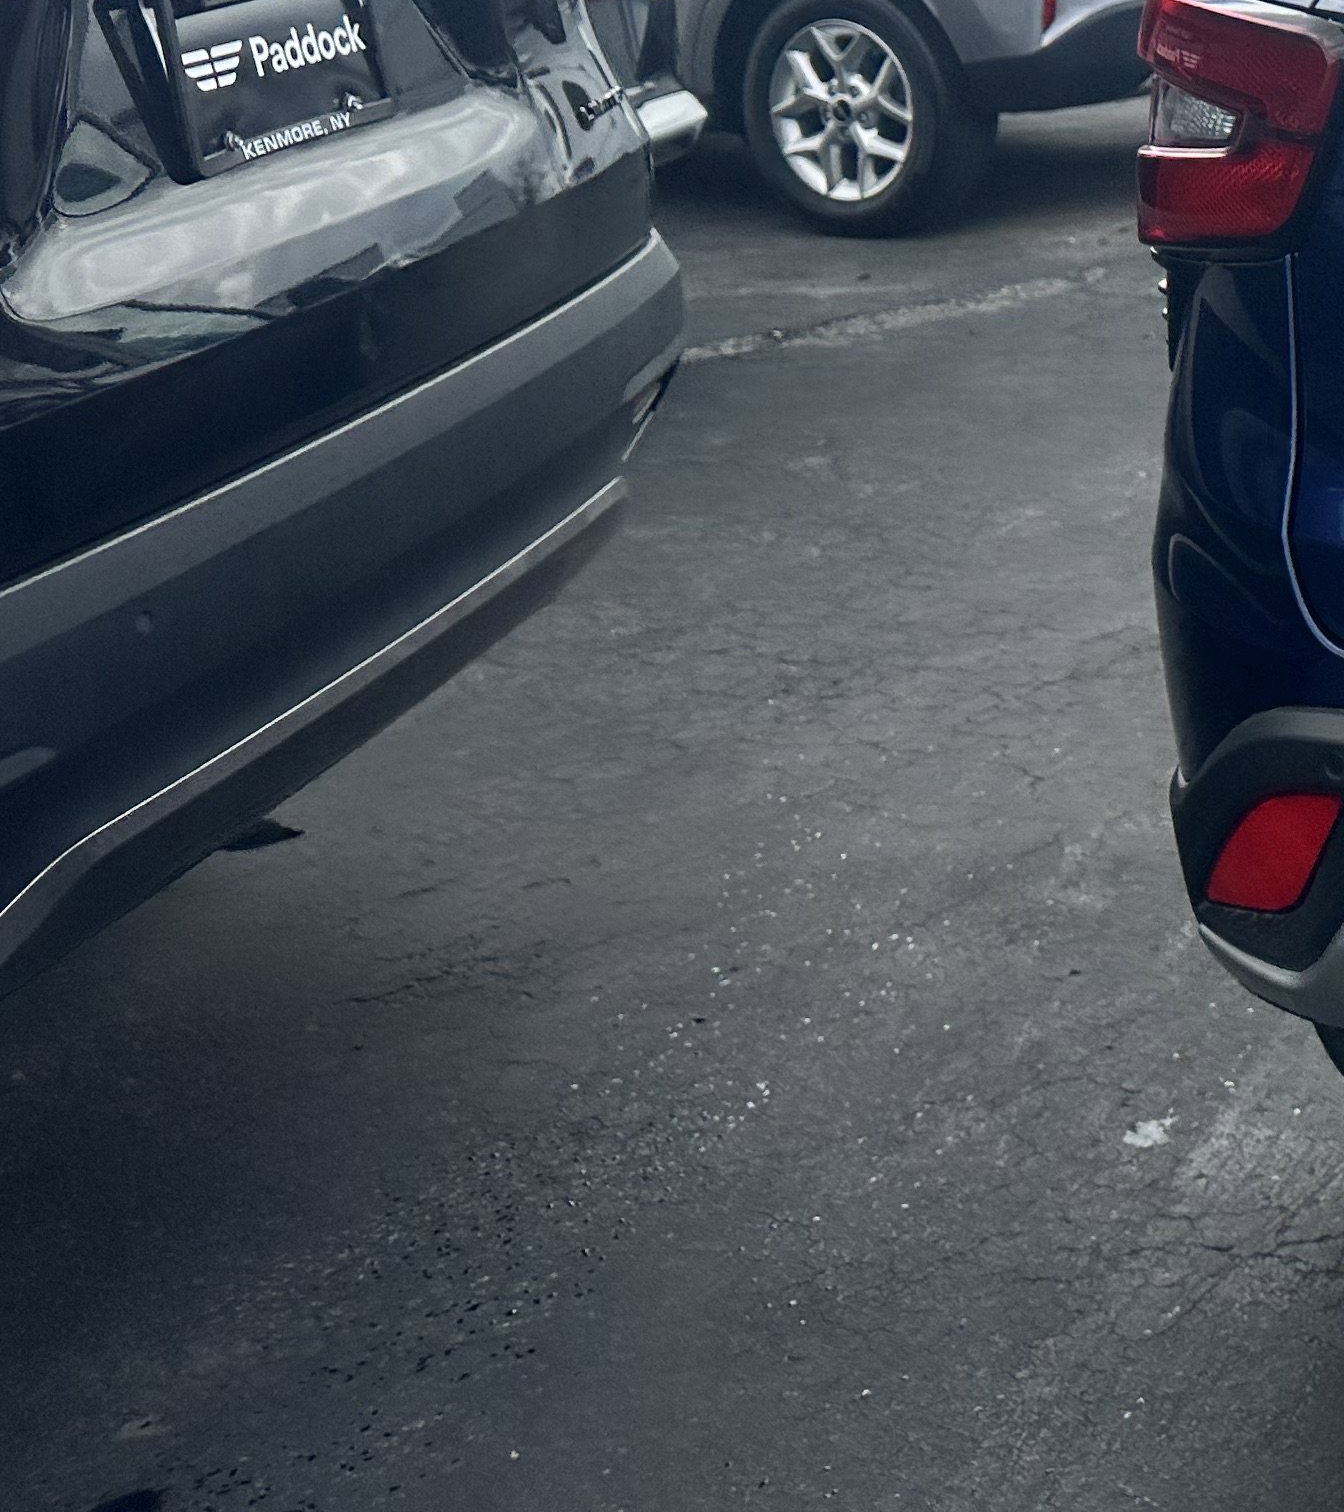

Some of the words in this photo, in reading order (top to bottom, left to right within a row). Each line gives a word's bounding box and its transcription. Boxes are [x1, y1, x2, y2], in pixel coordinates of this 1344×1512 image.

[249, 14, 367, 77] Paddock
[242, 119, 329, 160] KENMORE,
[330, 112, 351, 131] NY
